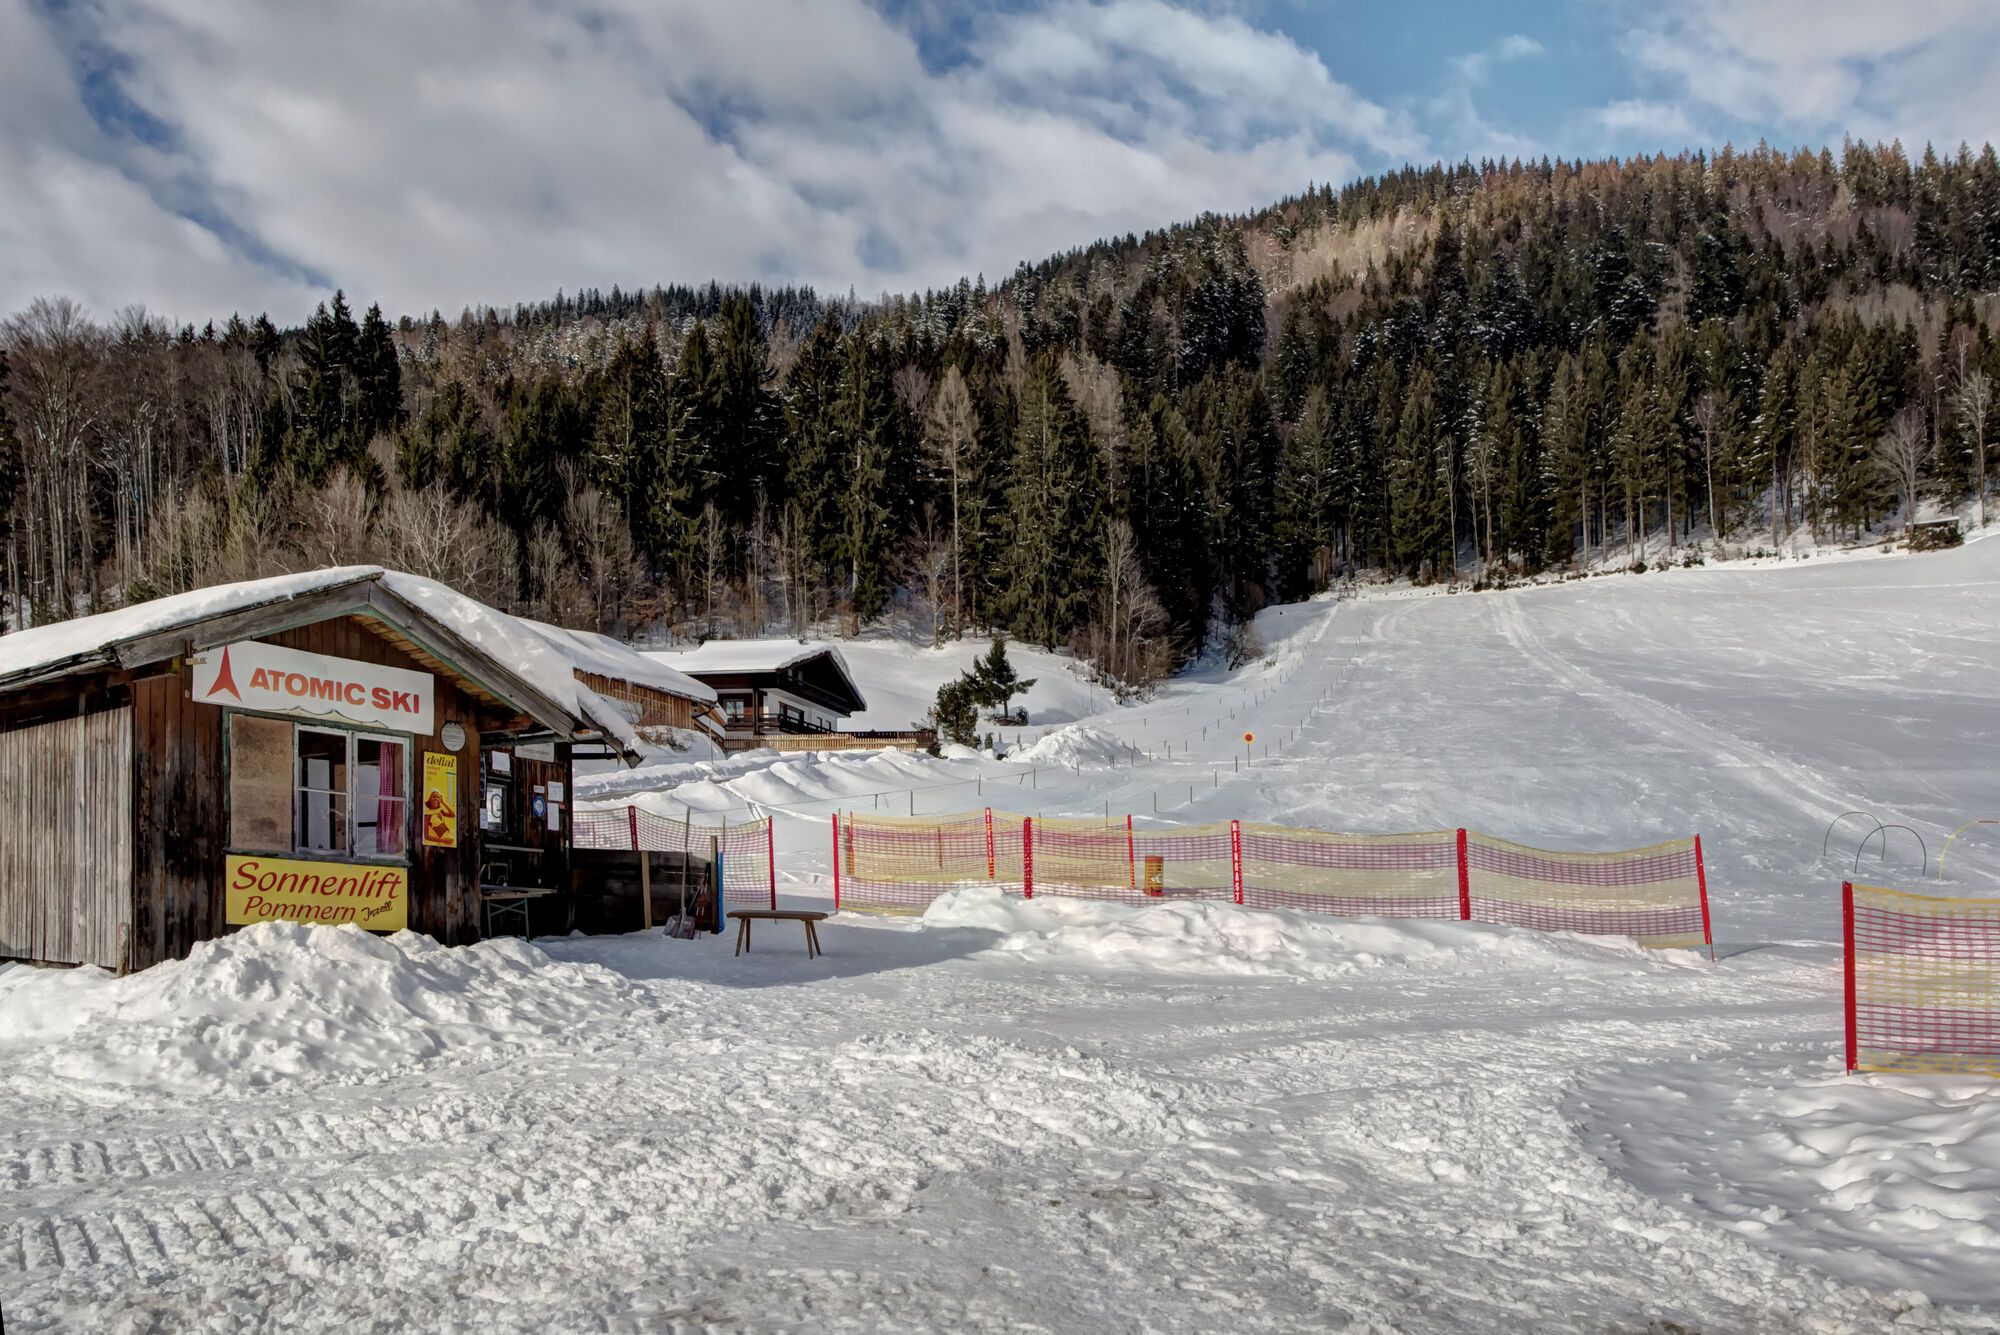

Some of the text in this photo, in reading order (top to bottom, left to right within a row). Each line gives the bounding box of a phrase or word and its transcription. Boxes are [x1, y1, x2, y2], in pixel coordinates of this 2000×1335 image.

[249, 667, 420, 714] ATOMIC SKI
[232, 861, 402, 900] Sonnenlift
[243, 895, 356, 921] Pommern
